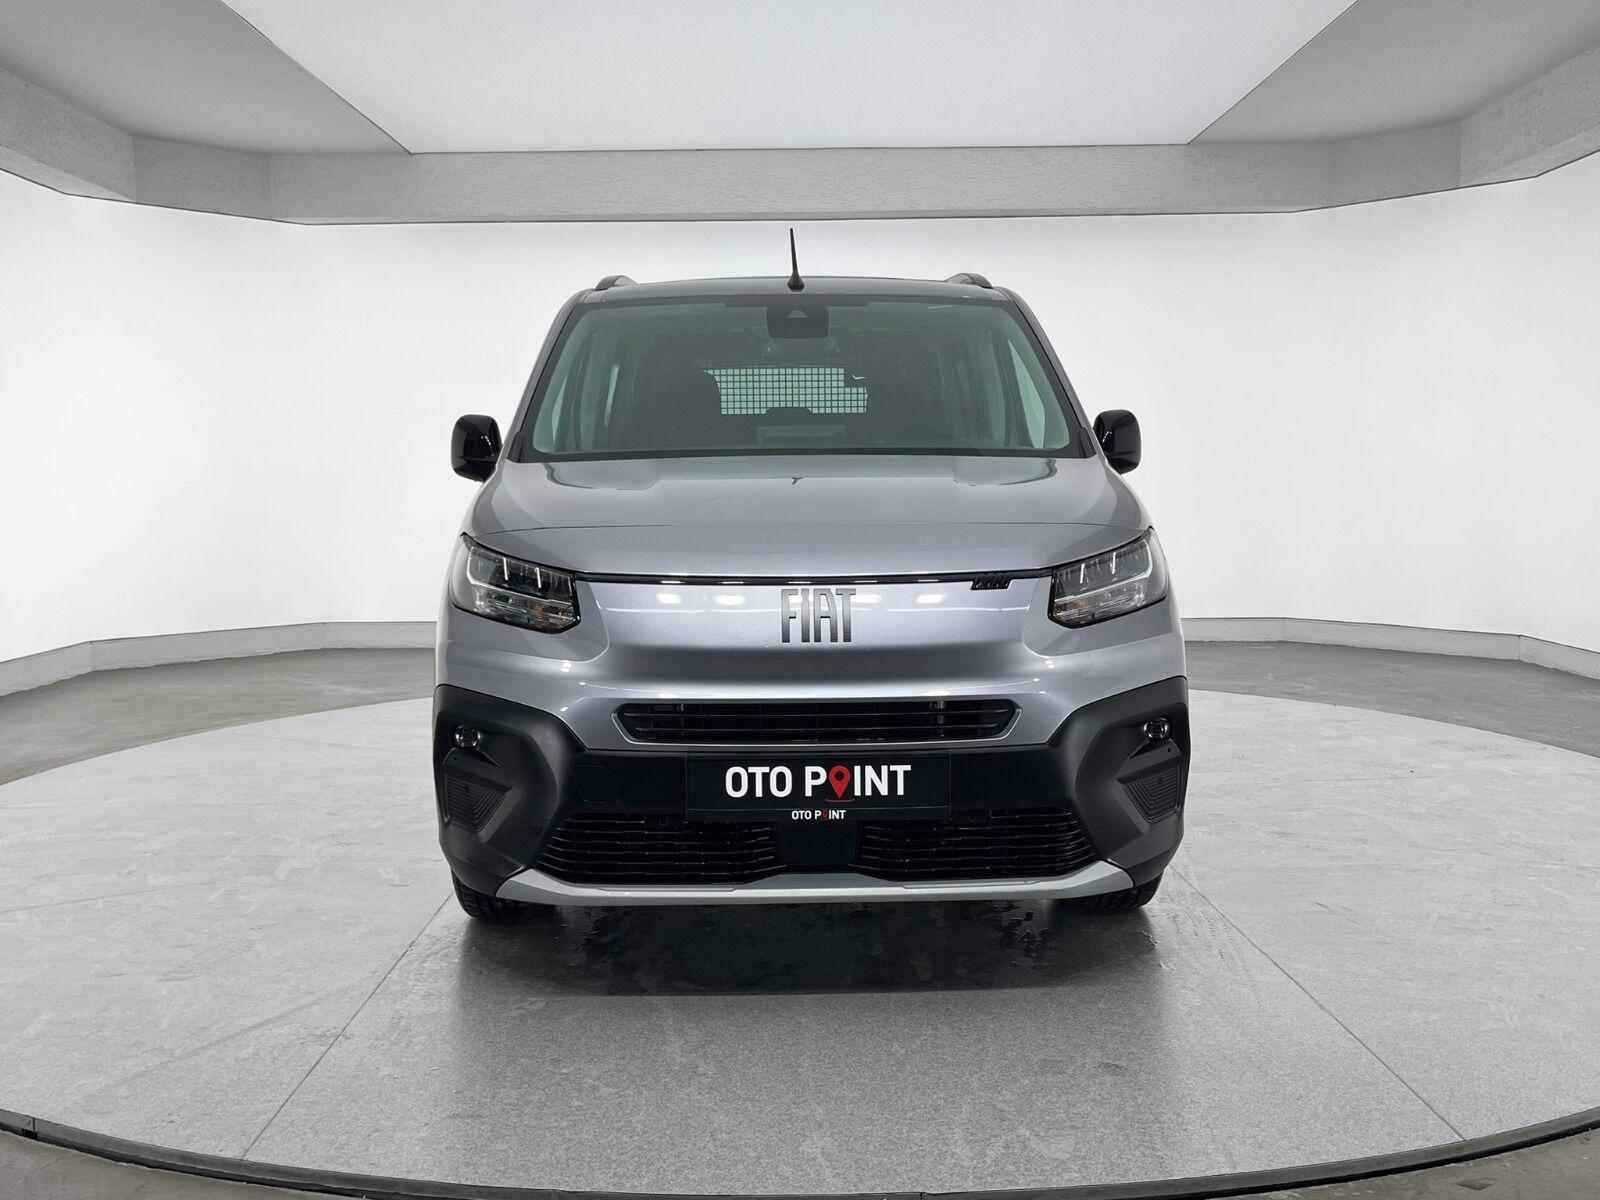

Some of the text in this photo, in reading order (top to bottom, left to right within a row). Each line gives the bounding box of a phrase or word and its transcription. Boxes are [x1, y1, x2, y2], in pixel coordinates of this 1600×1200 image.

[781, 588, 856, 643] FIAT
[725, 765, 793, 798] OTO
[791, 810, 812, 820] OTO
